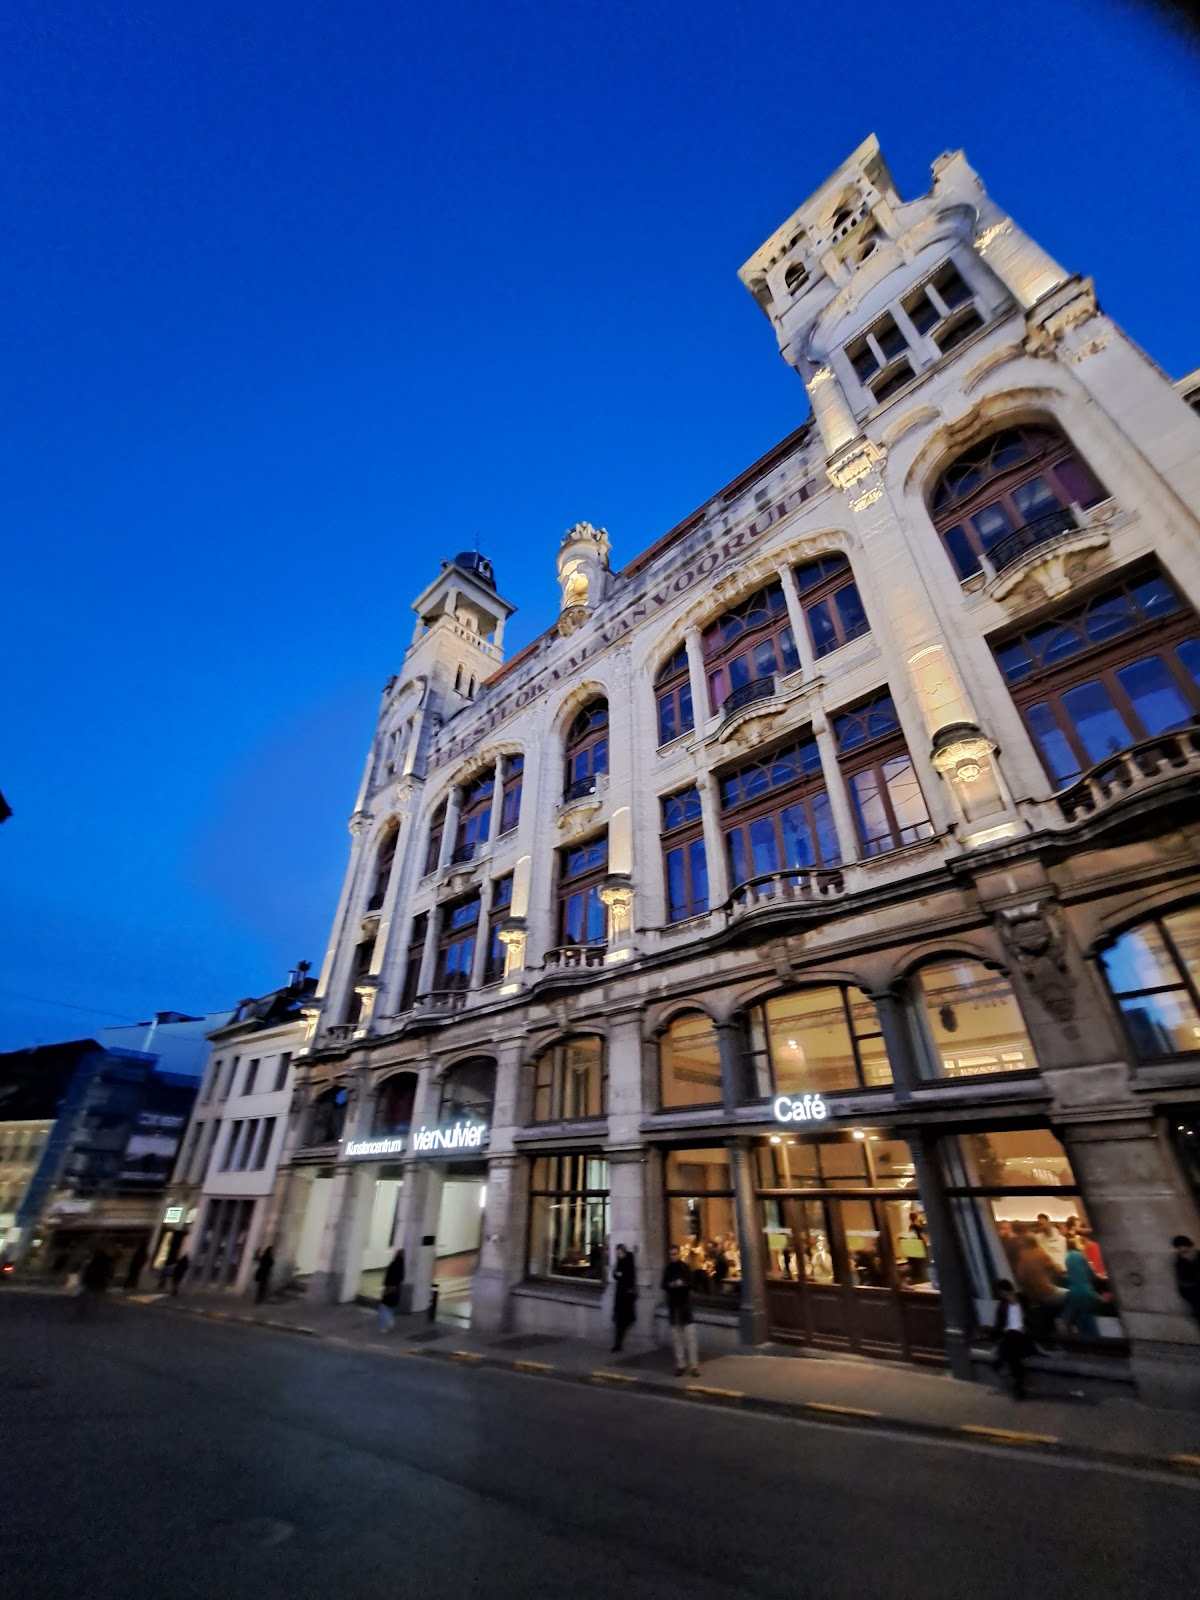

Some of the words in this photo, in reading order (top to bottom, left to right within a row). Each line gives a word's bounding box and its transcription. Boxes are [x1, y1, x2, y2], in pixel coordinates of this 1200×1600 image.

[601, 600, 653, 644] VAN
[651, 478, 817, 607] VOORUIT
[774, 1093, 826, 1122] Café
[345, 1138, 402, 1156] Kunstencentrum
